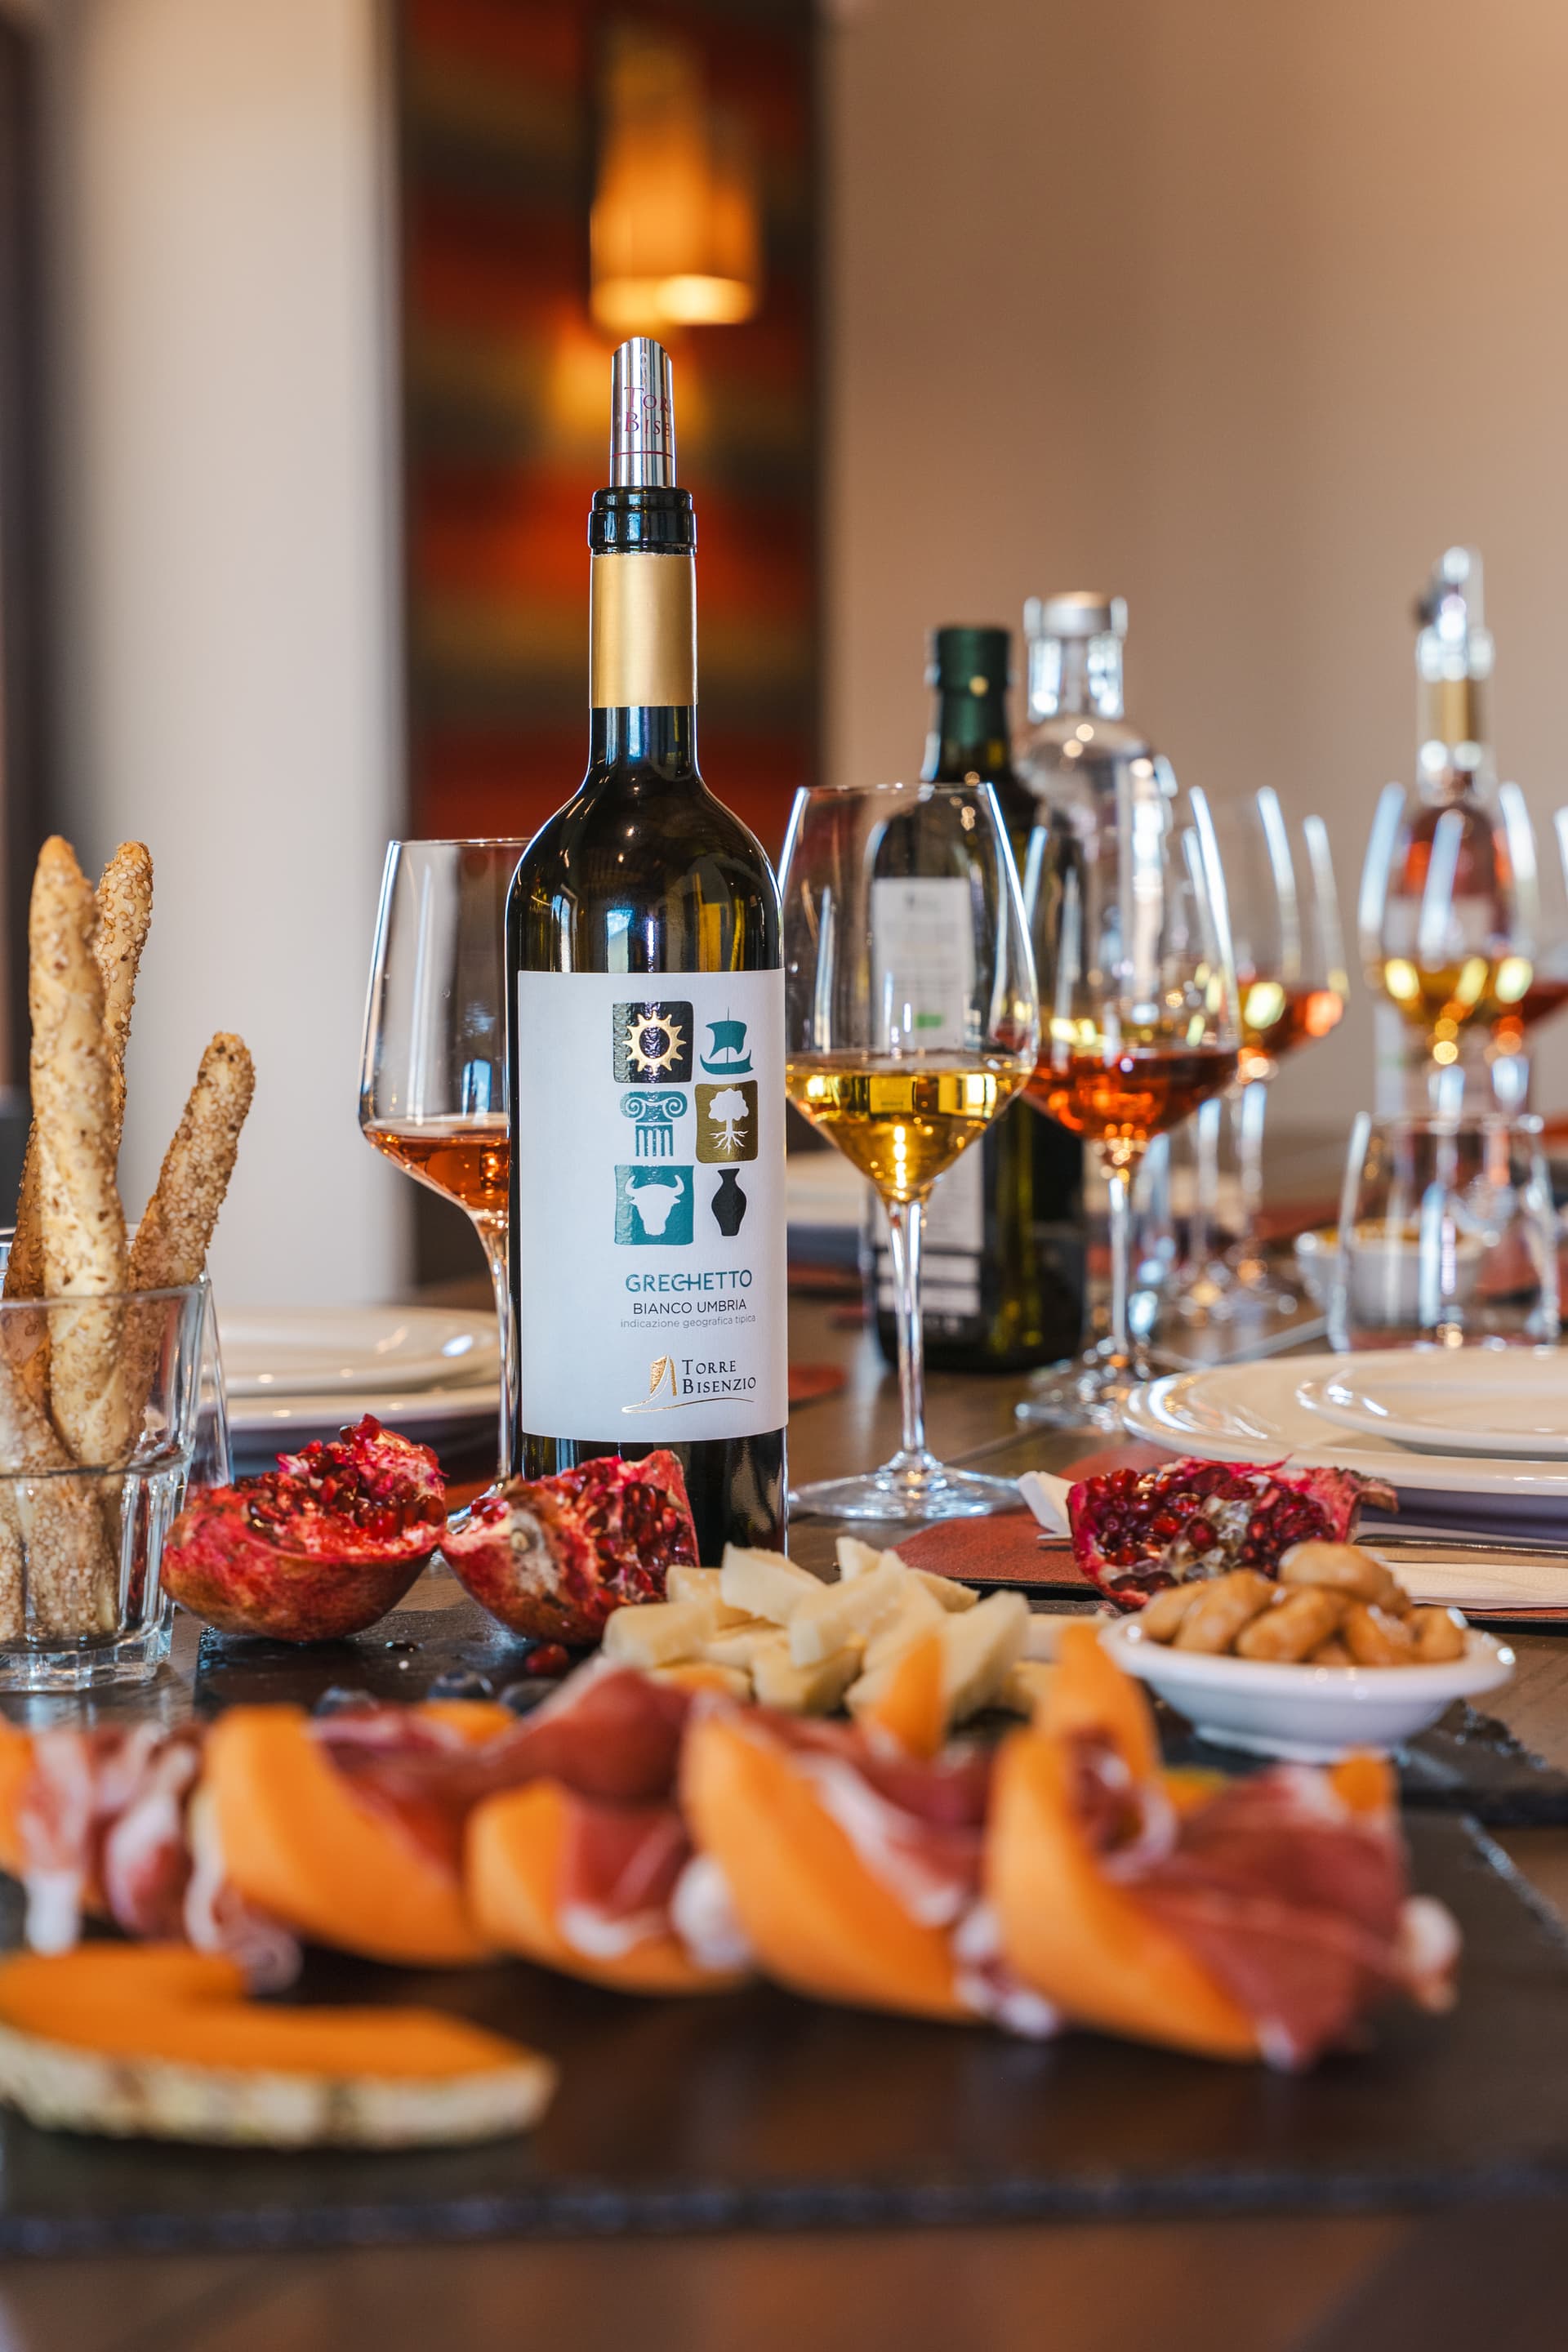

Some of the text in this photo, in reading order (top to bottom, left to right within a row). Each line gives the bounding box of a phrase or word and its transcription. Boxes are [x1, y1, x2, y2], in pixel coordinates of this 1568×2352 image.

[633, 1298, 747, 1315] BIANCO UMBRIA
[621, 1313, 756, 1329] indicazione geografica tipica
[682, 1358, 737, 1375] TORRE
[683, 1377, 756, 1395] BISENZIO
